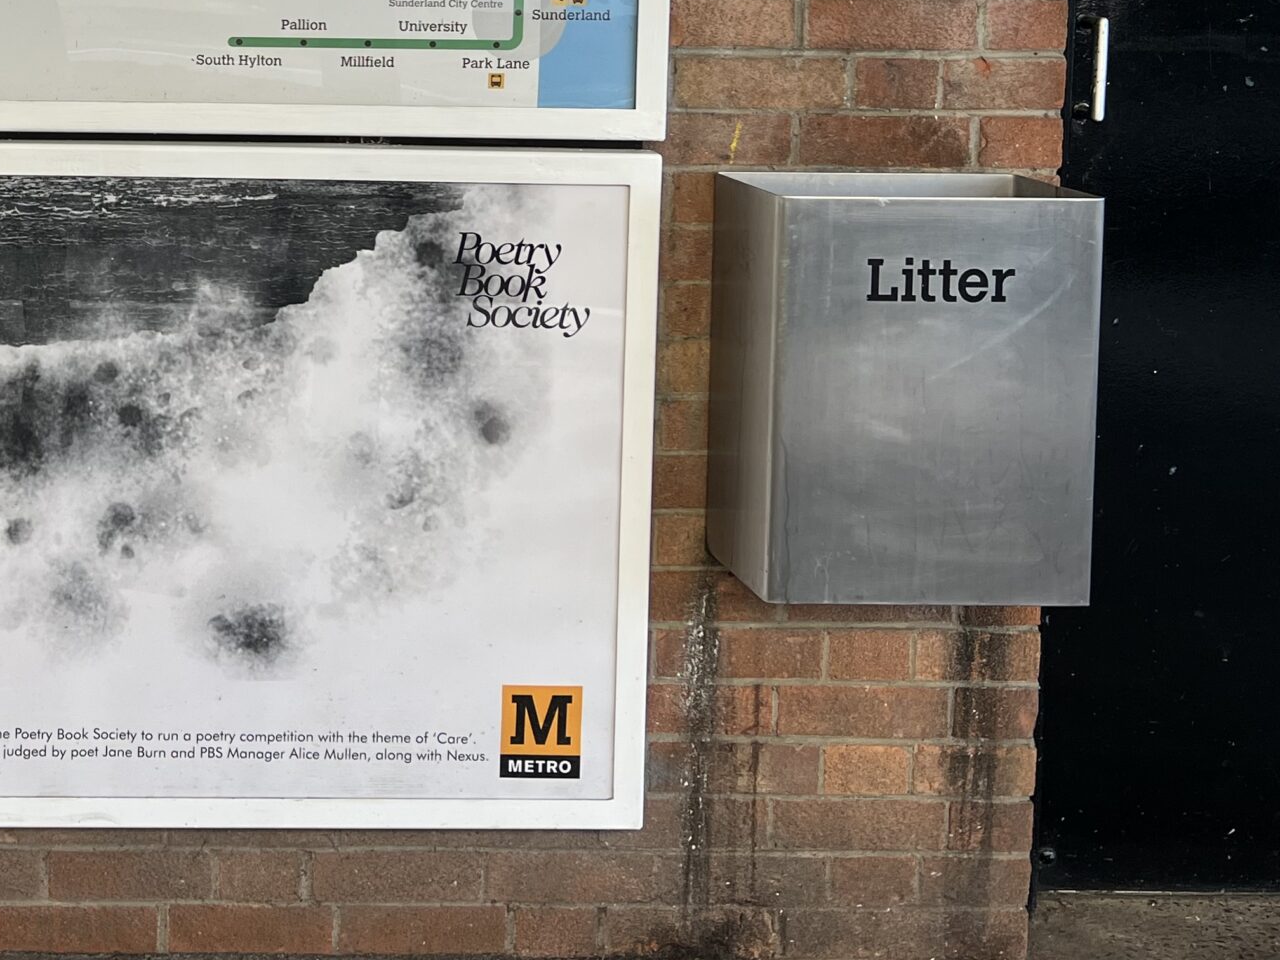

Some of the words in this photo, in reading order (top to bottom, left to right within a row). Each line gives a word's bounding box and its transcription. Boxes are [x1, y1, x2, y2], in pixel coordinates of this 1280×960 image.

[448, 0, 468, 10] City
[470, 0, 503, 8] Centre
[532, 9, 610, 22] Sunderland
[281, 19, 327, 31] Pallion
[398, 21, 467, 34] University
[196, 54, 234, 67] South
[238, 54, 282, 68] Hylton
[341, 56, 394, 68] Millfield
[462, 58, 494, 69] Park
[498, 58, 529, 70] Lane
[452, 232, 561, 274] Poetry
[456, 264, 547, 302] Book
[867, 258, 1016, 303] Litter
[467, 295, 590, 337] Society
[15, 728, 52, 742] Poetry
[58, 728, 88, 740] Book
[94, 729, 137, 743] Society
[141, 731, 152, 741] to
[158, 732, 178, 741] run
[183, 732, 191, 741] a
[196, 731, 235, 744] poetry
[240, 731, 314, 745] competition
[318, 731, 344, 743] with
[349, 732, 367, 744] the
[372, 732, 410, 744] theme
[416, 732, 428, 744] of
[508, 760, 571, 774] METRO
